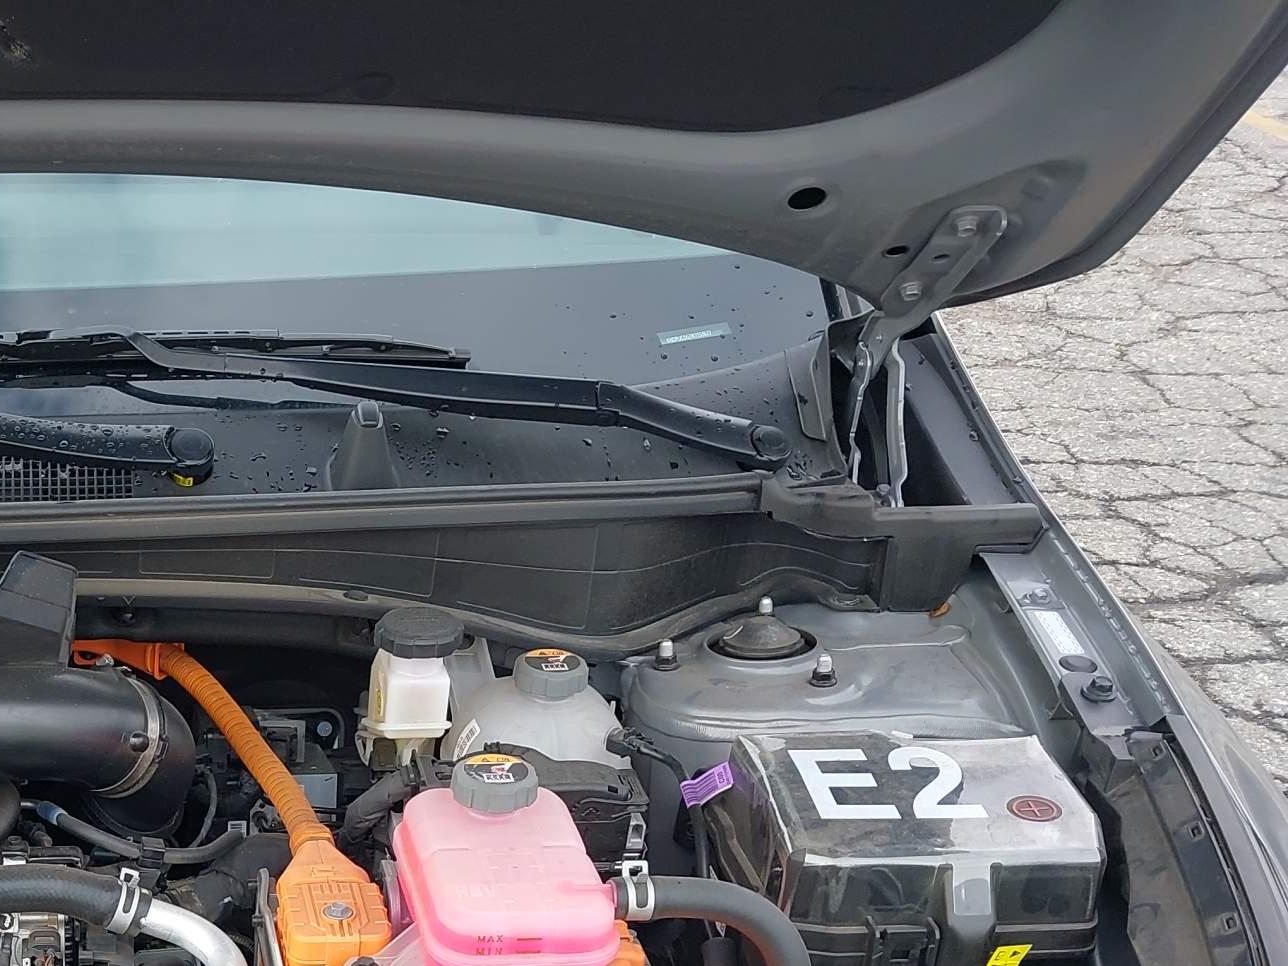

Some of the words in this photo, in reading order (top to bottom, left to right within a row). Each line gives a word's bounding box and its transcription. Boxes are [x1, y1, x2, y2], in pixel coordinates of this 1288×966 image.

[786, 745, 990, 820] E2
[477, 934, 504, 944] MAX
[475, 947, 503, 956] MIN
